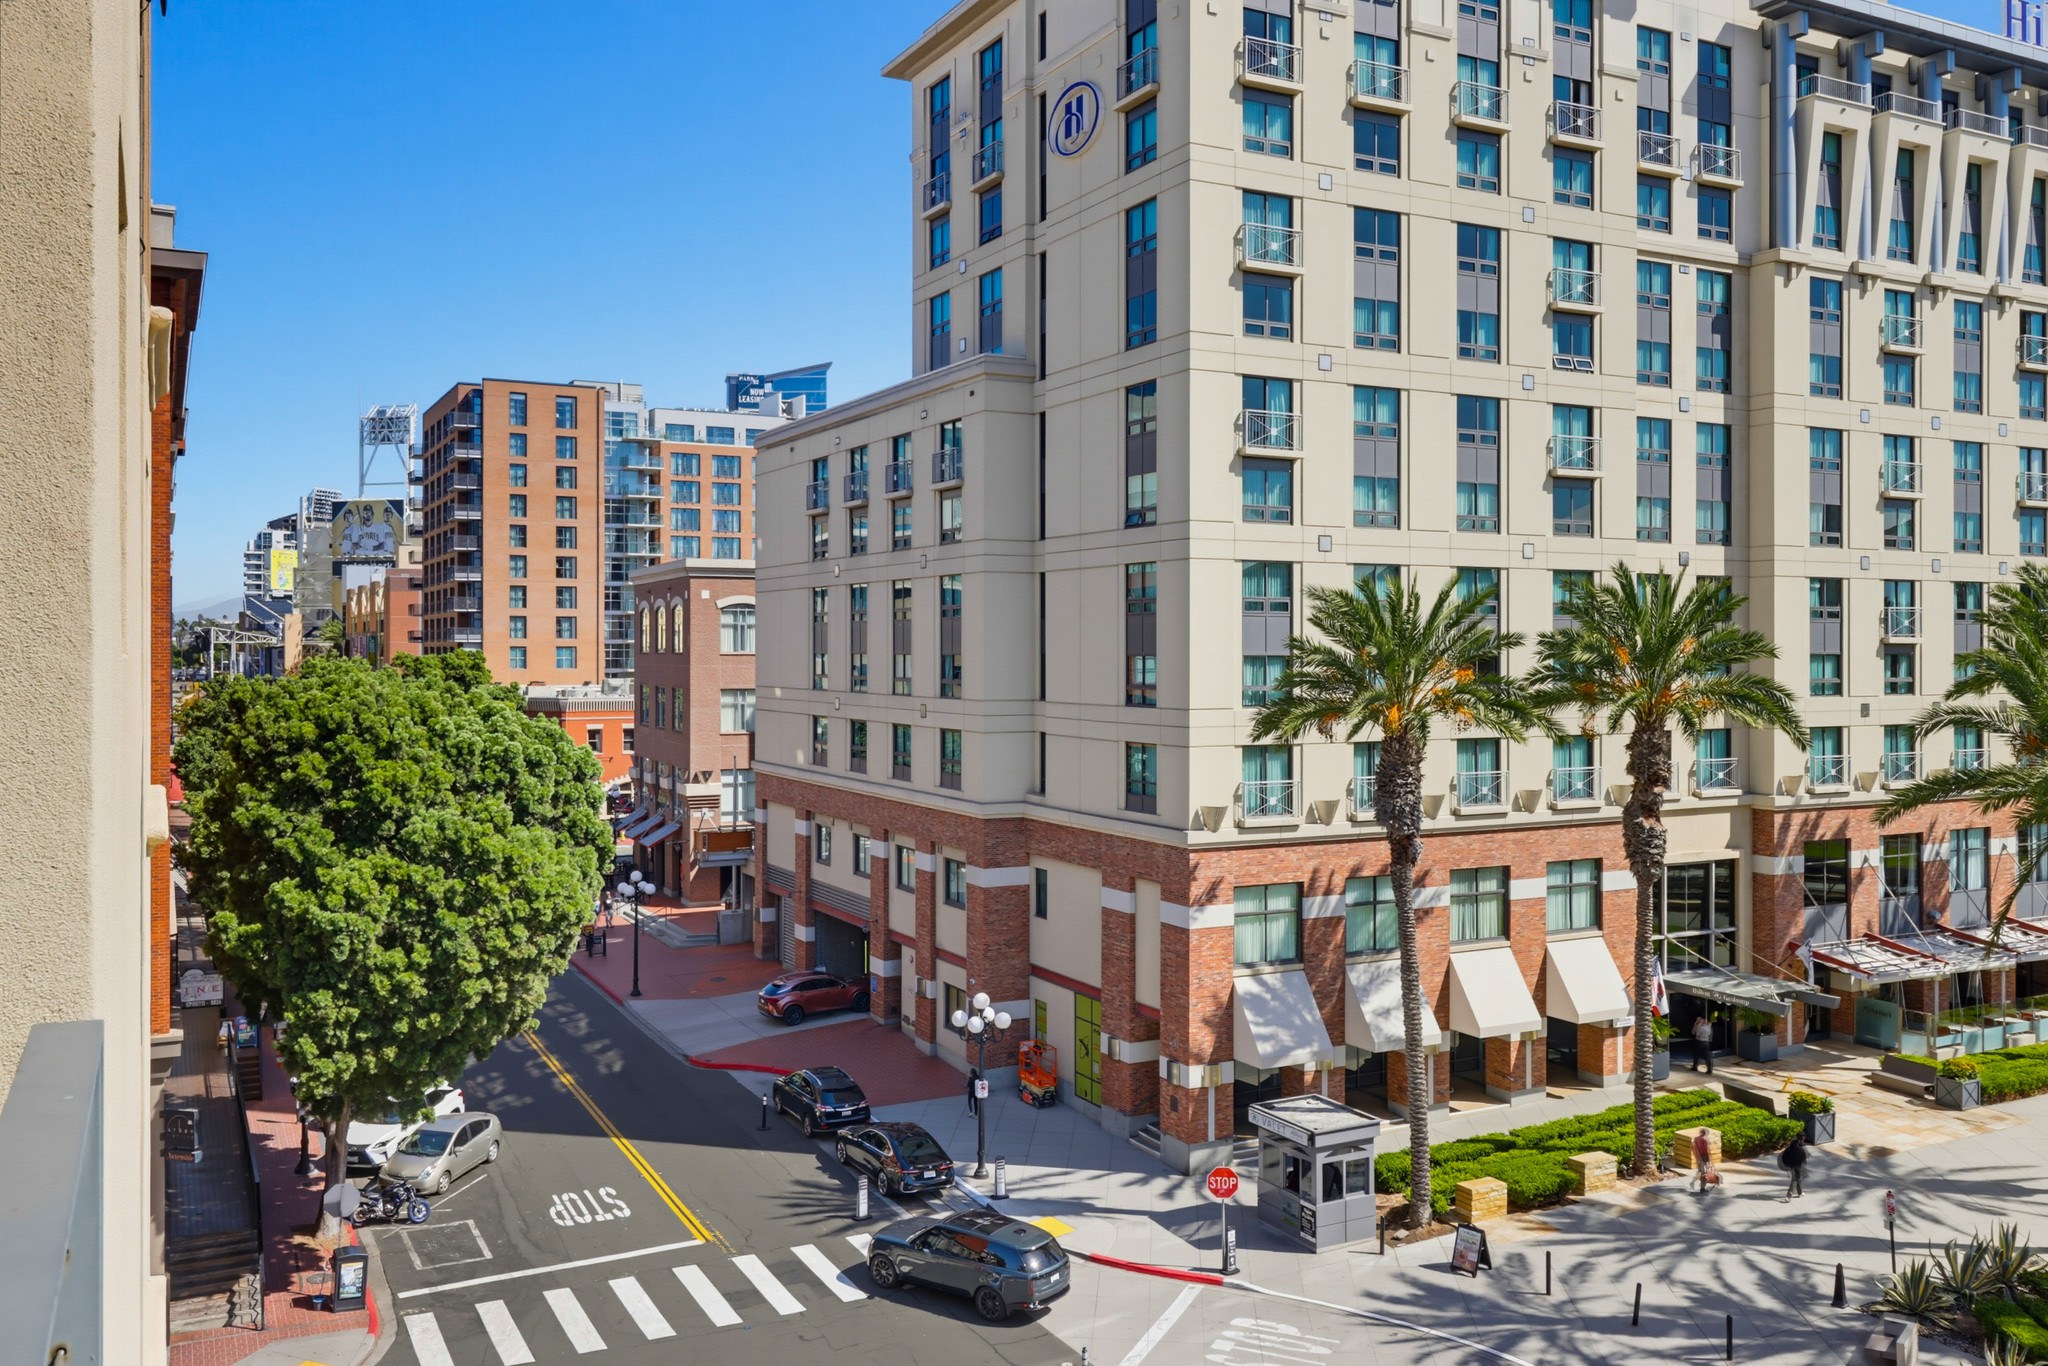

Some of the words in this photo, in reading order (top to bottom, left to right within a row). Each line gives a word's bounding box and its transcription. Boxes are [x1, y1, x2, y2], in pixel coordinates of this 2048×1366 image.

[2004, 0, 2048, 48] Hi
[749, 388, 765, 396] NOW
[1261, 1116, 1286, 1134] VALET
[1209, 1176, 1237, 1189] STOP
[549, 1186, 632, 1227] STOP
